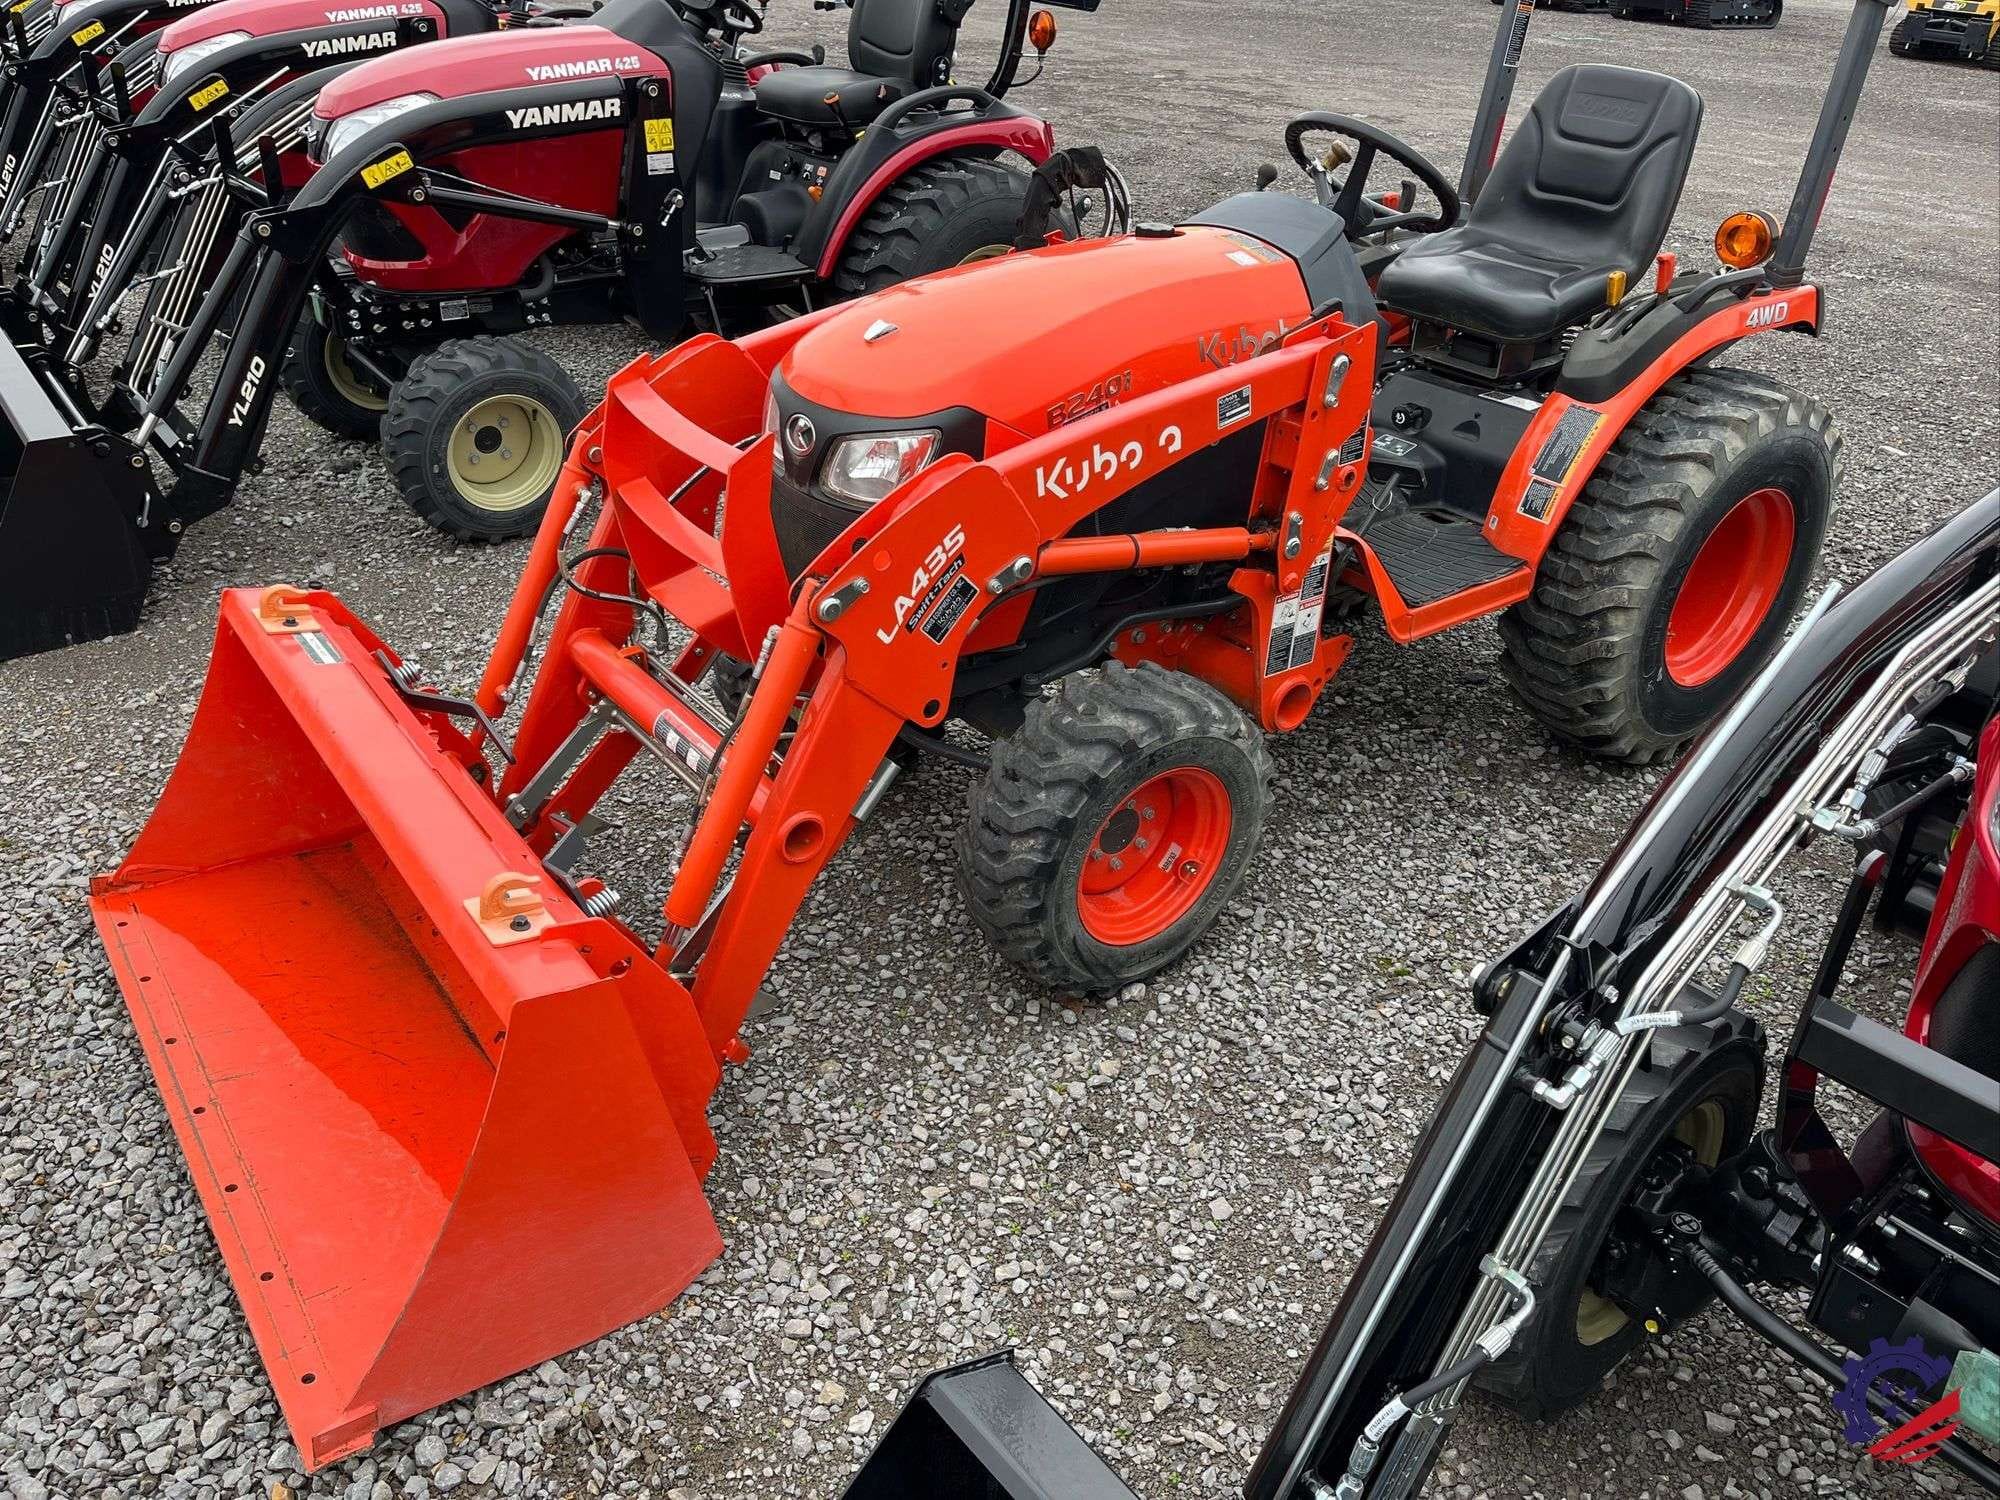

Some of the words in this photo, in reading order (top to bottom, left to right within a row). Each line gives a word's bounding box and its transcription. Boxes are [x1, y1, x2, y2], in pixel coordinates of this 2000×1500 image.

[325, 4, 397, 23] YANMAR
[401, 3, 423, 15] 425
[300, 31, 397, 58] YANMAR
[525, 58, 612, 81] YANMAR
[615, 56, 641, 70] 425
[505, 98, 621, 129] YANMAR
[1745, 301, 1788, 327] 4WD
[228, 355, 266, 427] YL210
[876, 523, 966, 644] LA435
[908, 558, 963, 630] Swift-Tach
